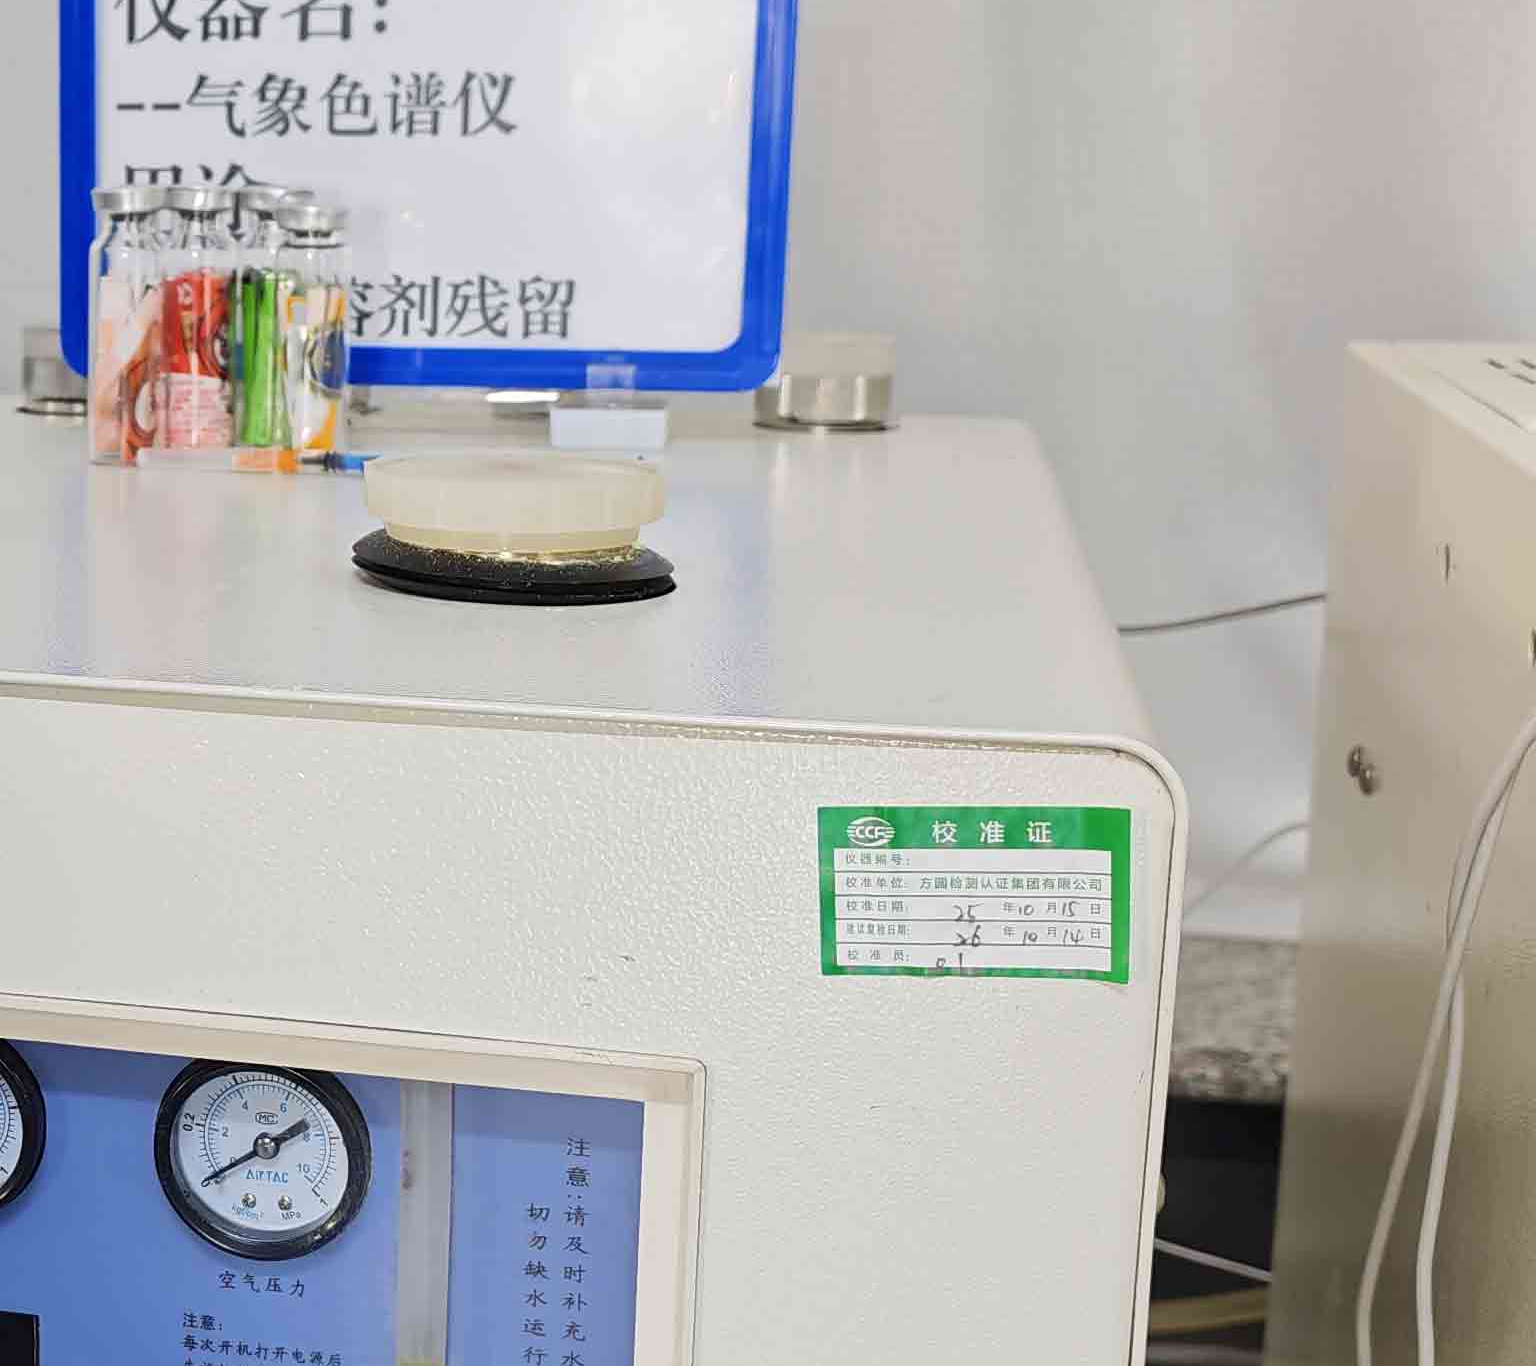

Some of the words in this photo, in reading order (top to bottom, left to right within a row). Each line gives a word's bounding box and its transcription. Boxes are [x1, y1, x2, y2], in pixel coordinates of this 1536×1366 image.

[932, 820, 1052, 844] 校准证
[218, 1271, 306, 1298] 空气压力
[182, 1312, 223, 1331] 注意:
